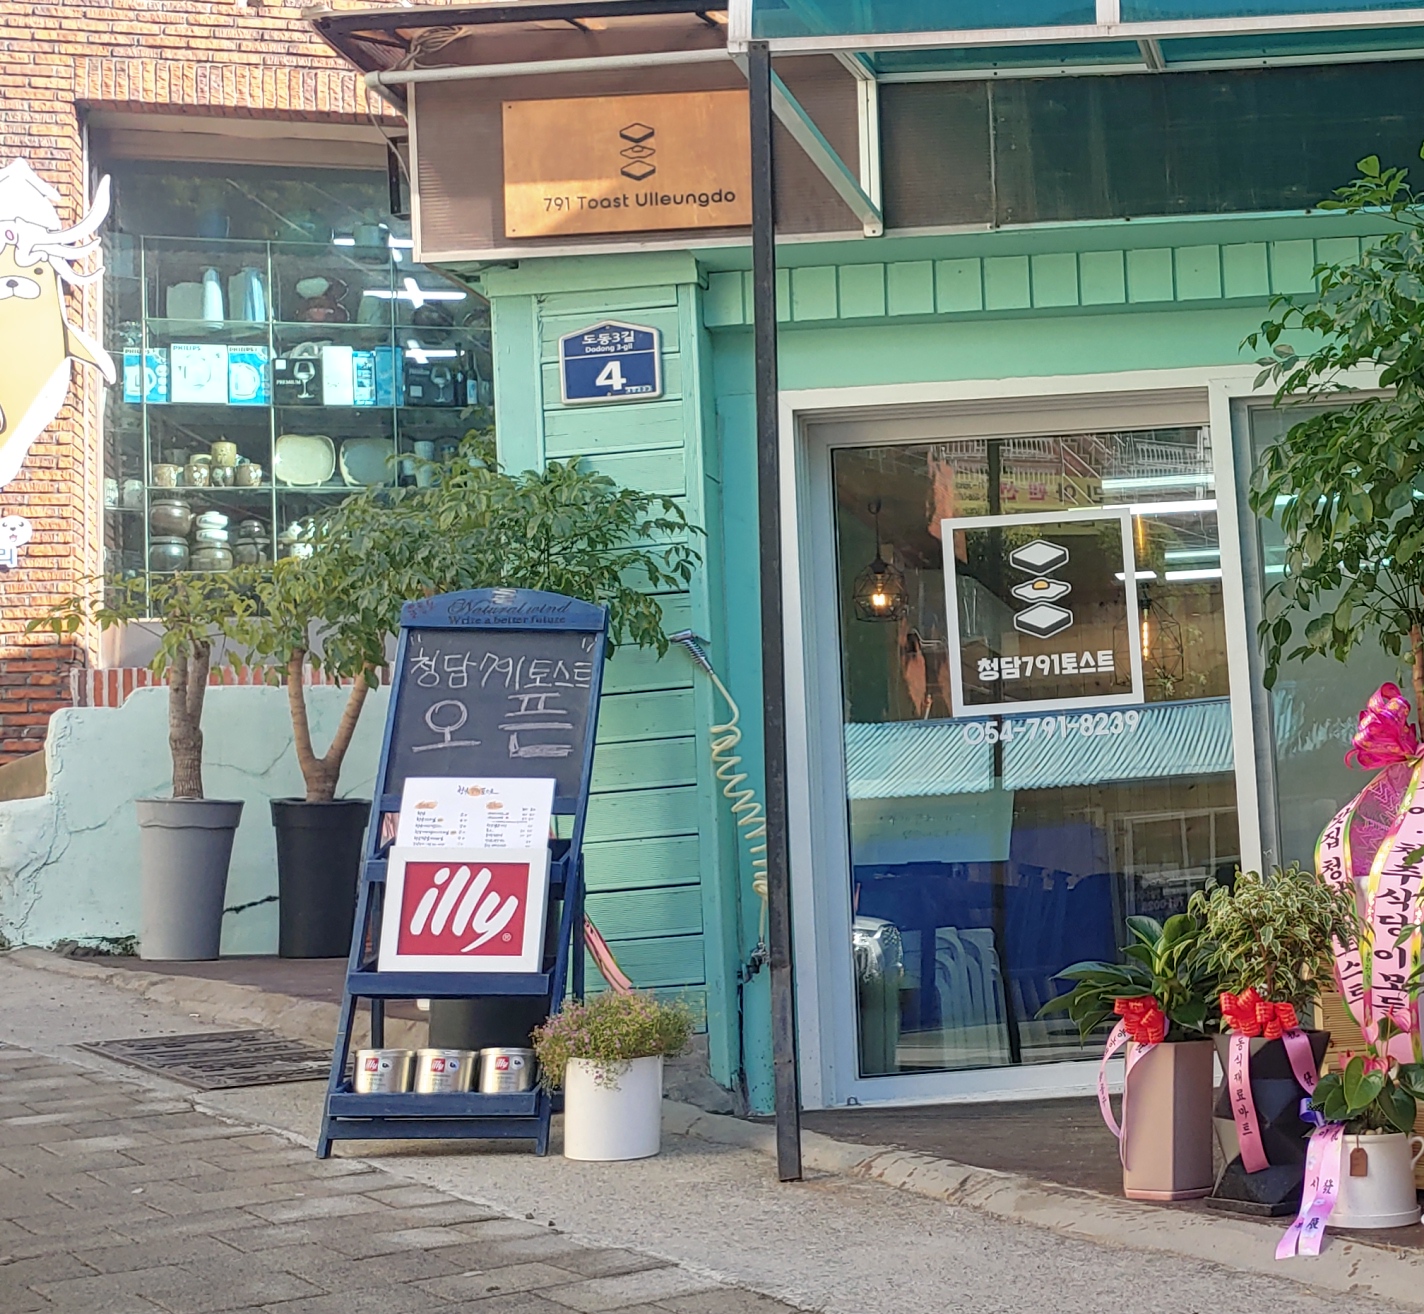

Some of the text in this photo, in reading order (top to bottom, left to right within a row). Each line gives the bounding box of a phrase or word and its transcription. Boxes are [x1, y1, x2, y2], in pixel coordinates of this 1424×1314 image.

[543, 188, 736, 212] 791 Toast Ulleungdo
[581, 330, 635, 346] 도동3길
[585, 343, 633, 353] Dodong 3-gil
[595, 360, 627, 391] 4
[447, 598, 525, 617] Natural
[448, 616, 483, 625] Write
[494, 615, 529, 625] better
[531, 615, 566, 624] future
[977, 650, 1115, 681] 청담791토스트
[409, 865, 519, 953] illy
[365, 1058, 379, 1072] illy
[431, 1058, 445, 1072] illy
[495, 1057, 509, 1071] illy
